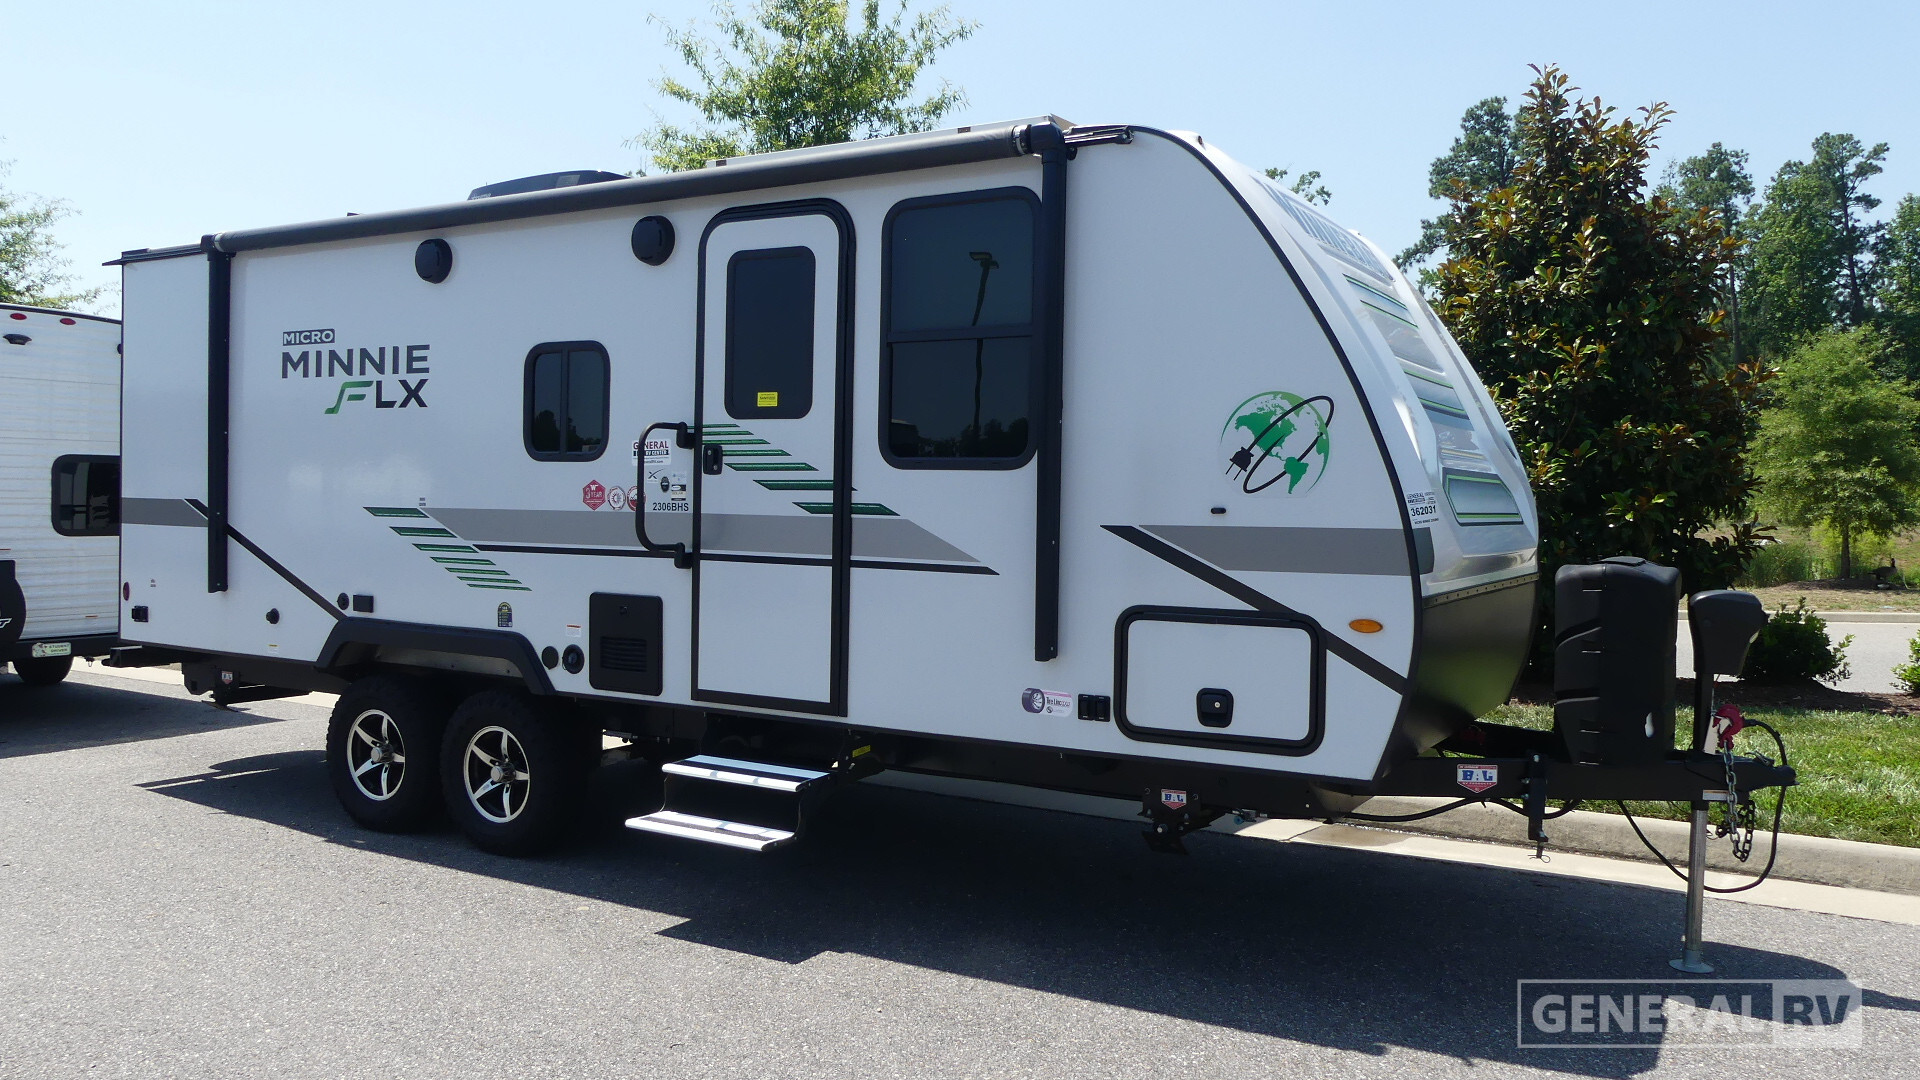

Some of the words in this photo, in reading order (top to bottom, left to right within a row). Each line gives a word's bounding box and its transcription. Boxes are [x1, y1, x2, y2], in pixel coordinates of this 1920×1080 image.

[283, 330, 334, 344] MICRO
[281, 344, 430, 379] MINNIE
[324, 379, 429, 414] FLX
[633, 441, 668, 449] GNERAL
[585, 488, 591, 499] 3
[652, 502, 689, 512] 2306BHS
[1411, 505, 1436, 516] 362031
